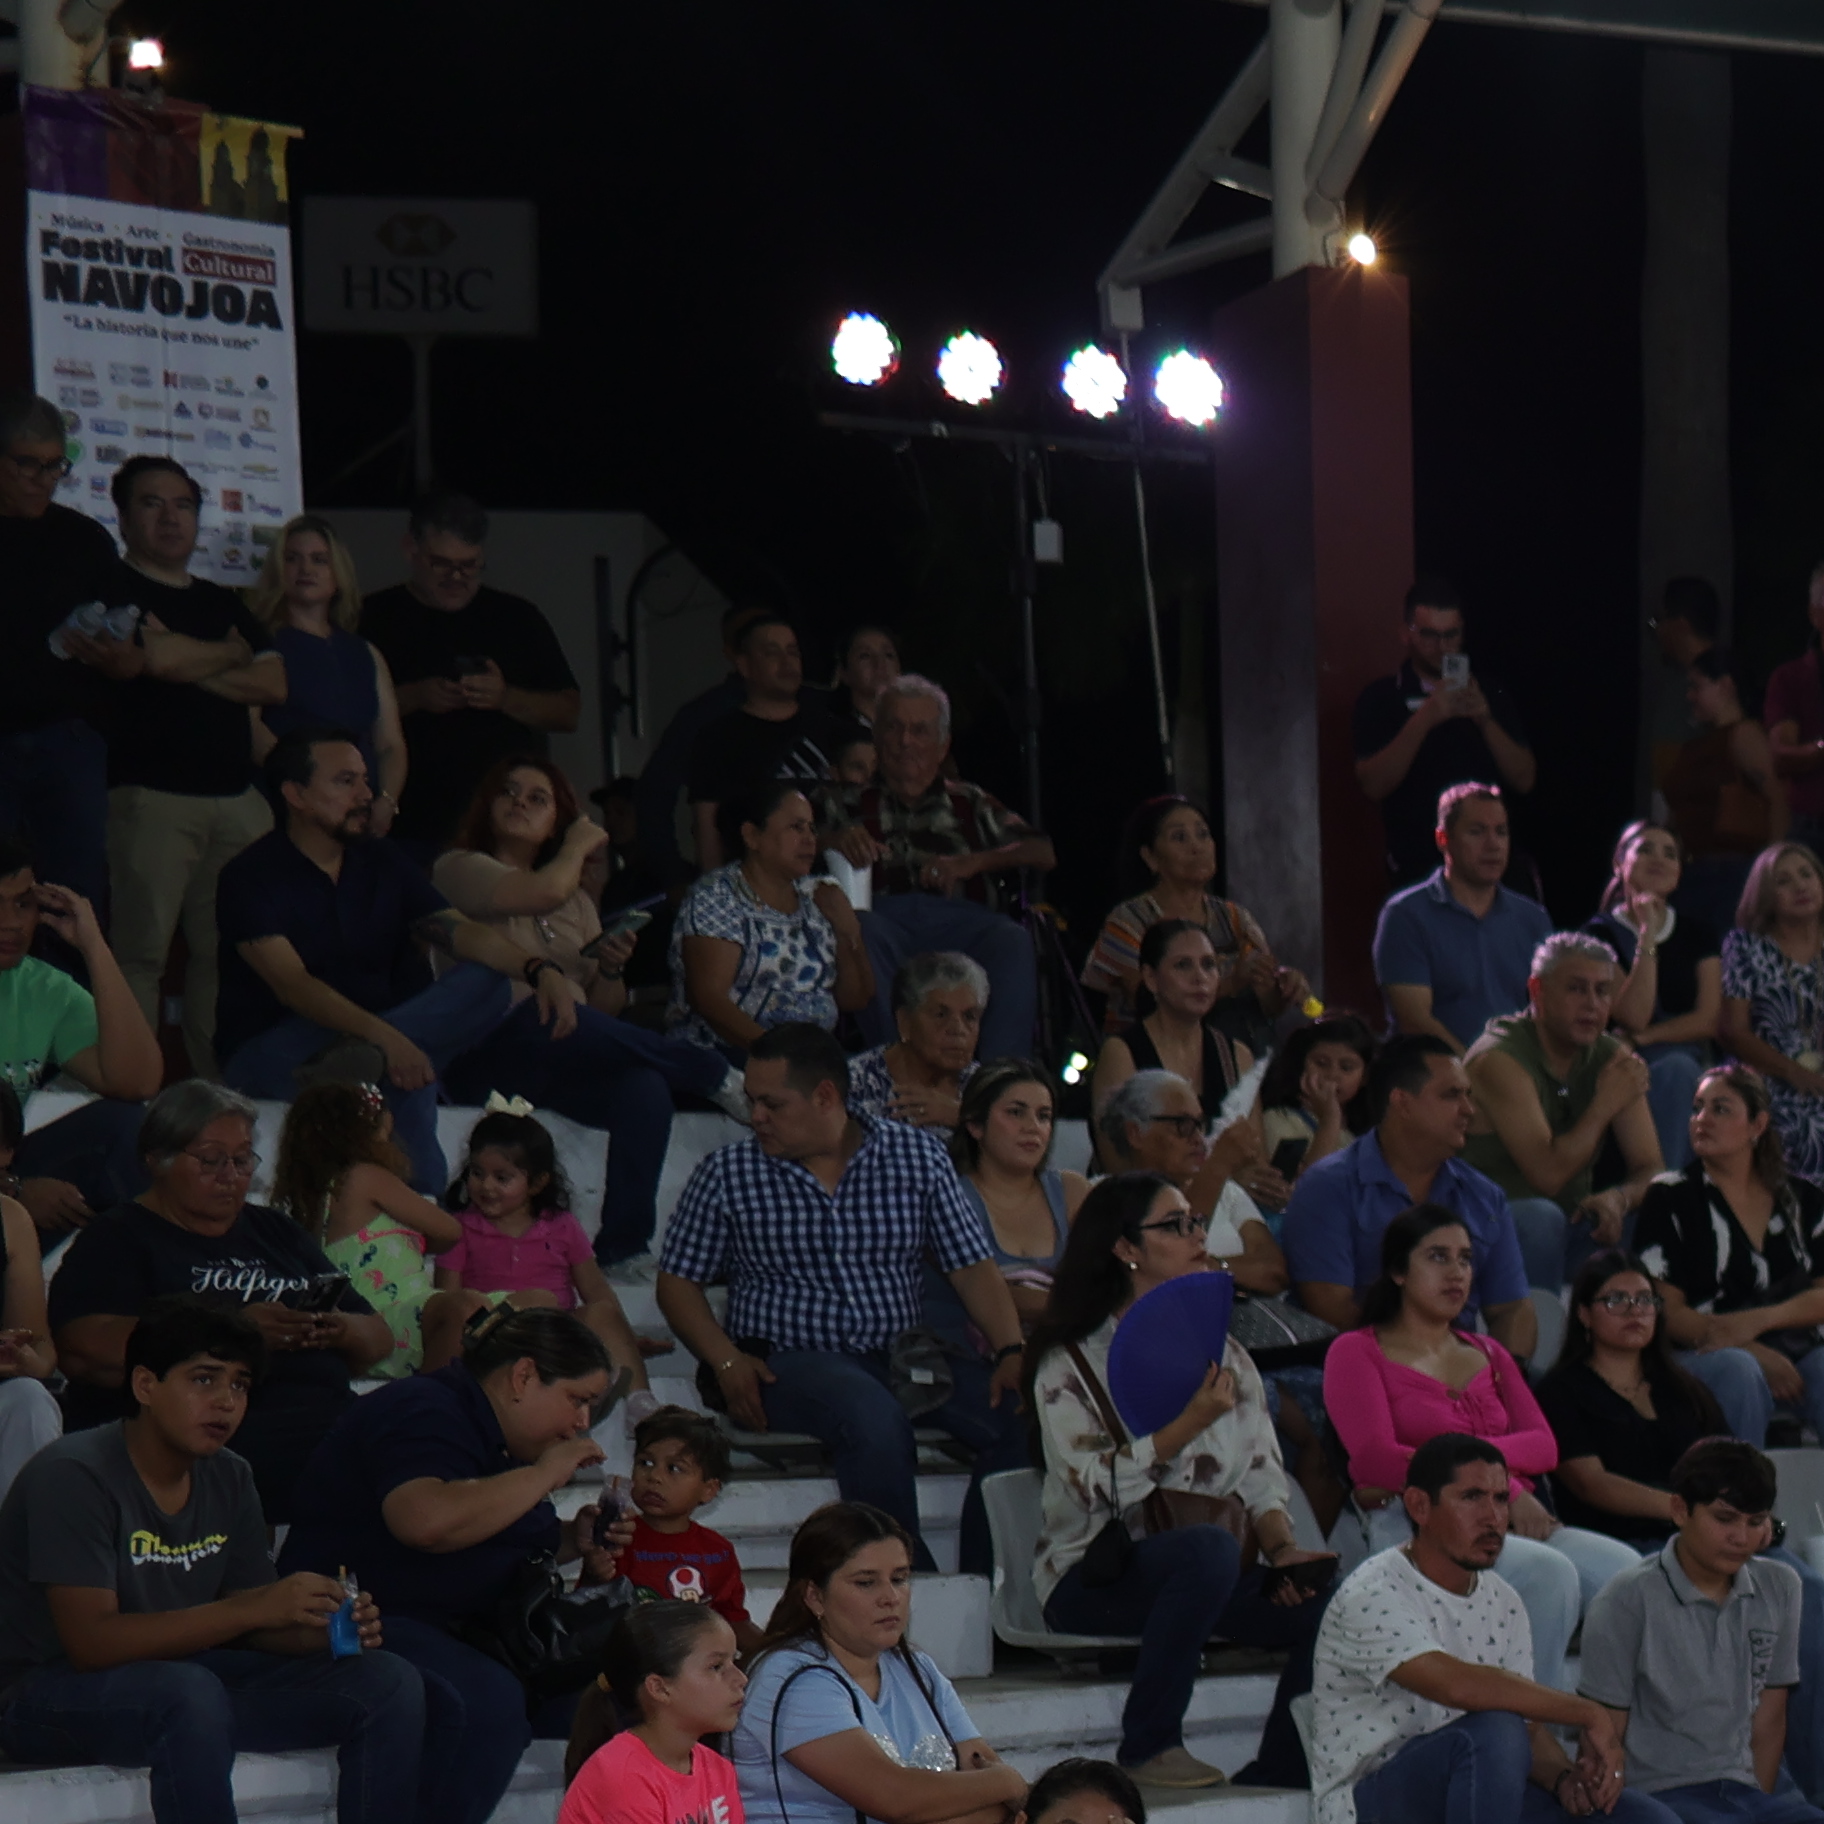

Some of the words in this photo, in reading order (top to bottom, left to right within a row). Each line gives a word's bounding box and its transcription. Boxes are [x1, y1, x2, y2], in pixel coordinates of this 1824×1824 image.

[127, 224, 159, 240] Arte
[40, 229, 174, 272] Festival
[184, 252, 274, 282] Cultural
[41, 260, 283, 331] NAVOJOA
[342, 264, 493, 313] HSBC
[97, 318, 158, 342] historia
[161, 328, 188, 345] que
[192, 332, 220, 346] nos
[191, 1265, 309, 1302] Hilfiger
